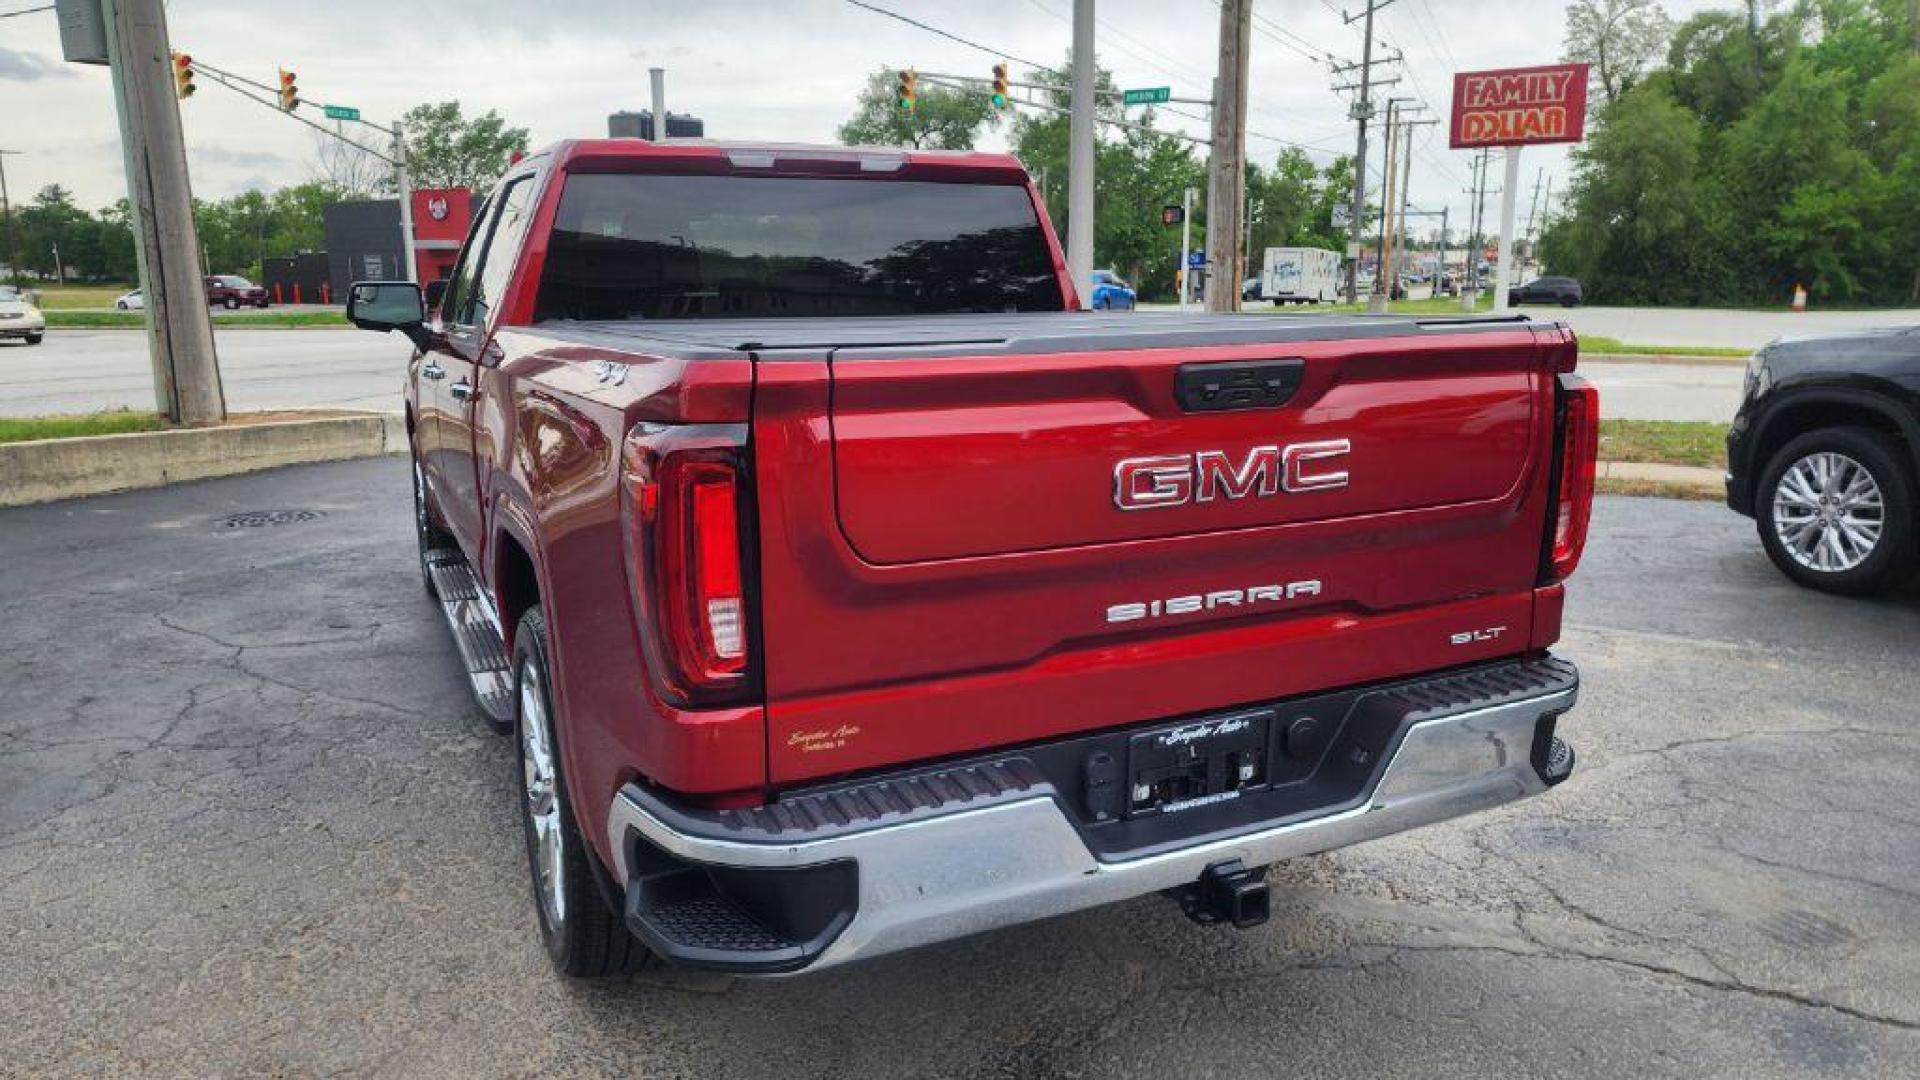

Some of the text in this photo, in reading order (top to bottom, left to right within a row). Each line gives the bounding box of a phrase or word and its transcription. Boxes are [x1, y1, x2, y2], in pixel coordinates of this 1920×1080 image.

[1464, 71, 1575, 107] FAMILY
[1461, 107, 1566, 141] DOLLAR
[1113, 438, 1350, 510] GMC
[1106, 579, 1321, 622] SIERRA
[1450, 626, 1507, 644] SLT
[1213, 719, 1242, 735] Auto
